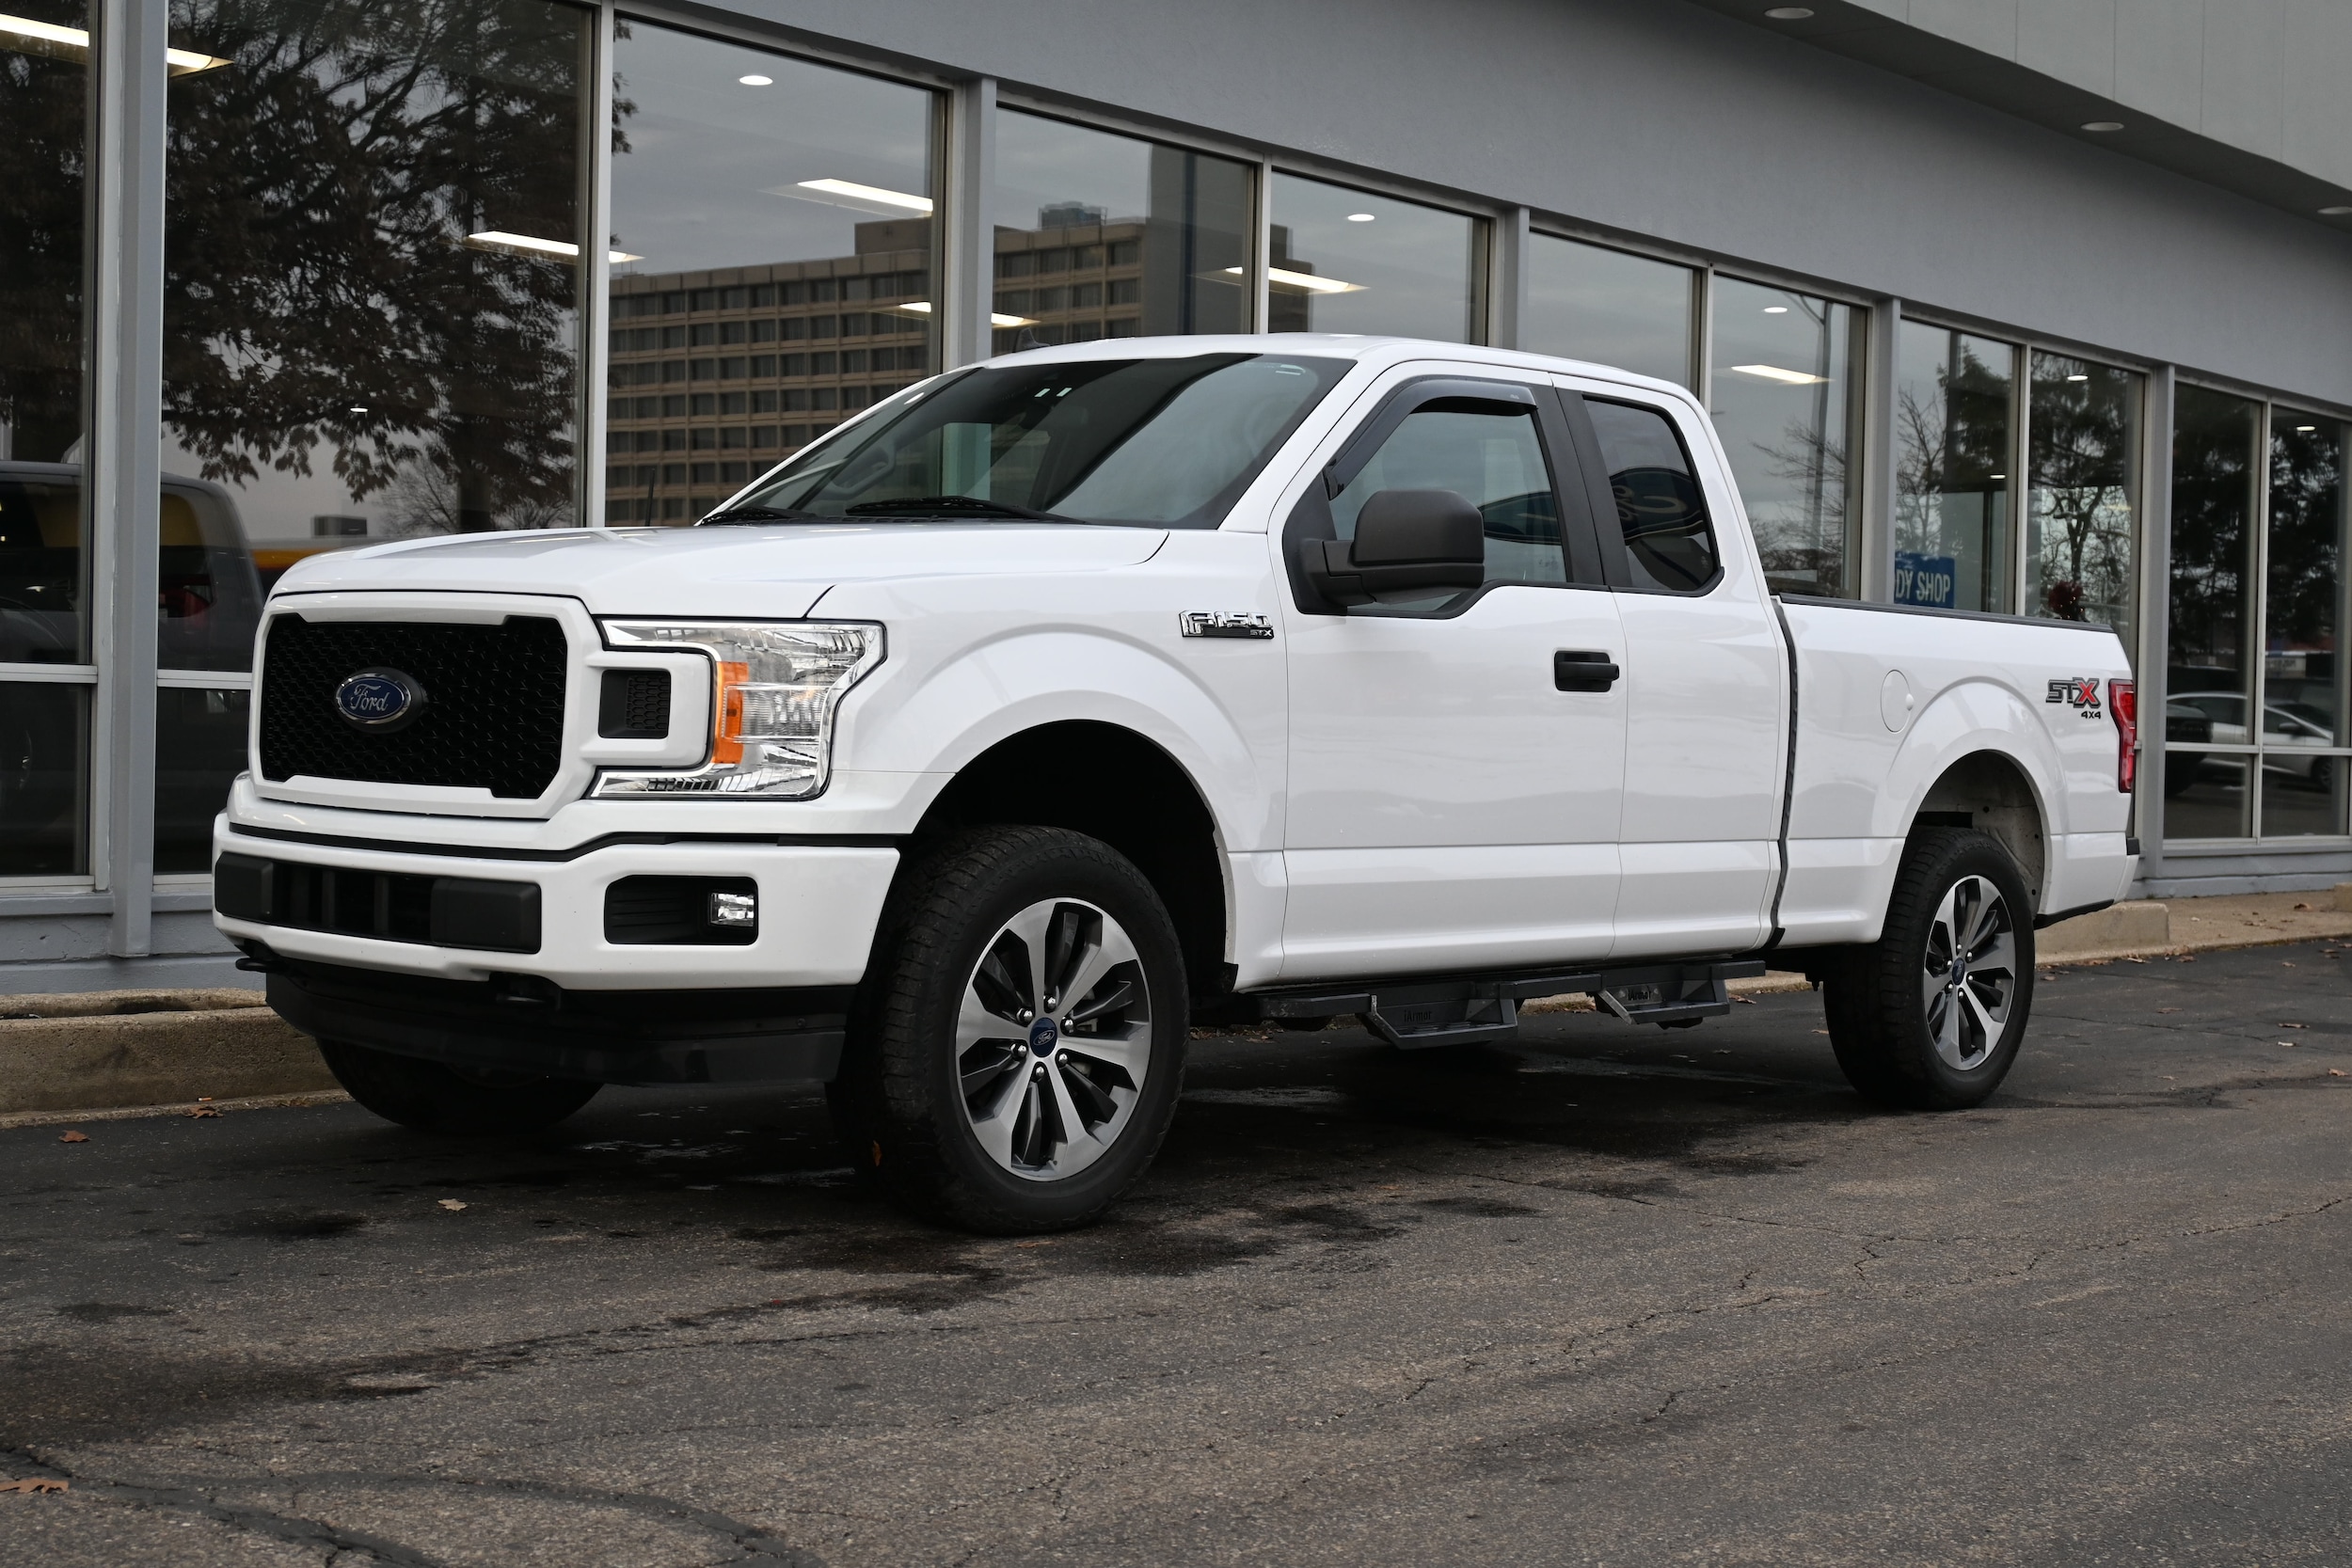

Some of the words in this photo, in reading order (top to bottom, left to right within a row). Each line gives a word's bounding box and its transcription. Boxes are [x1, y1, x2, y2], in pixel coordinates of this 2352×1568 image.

[1916, 570, 1951, 602] SHOP
[1249, 628, 1272, 637] STX
[349, 683, 390, 712] Ford
[2045, 677, 2101, 708] STX
